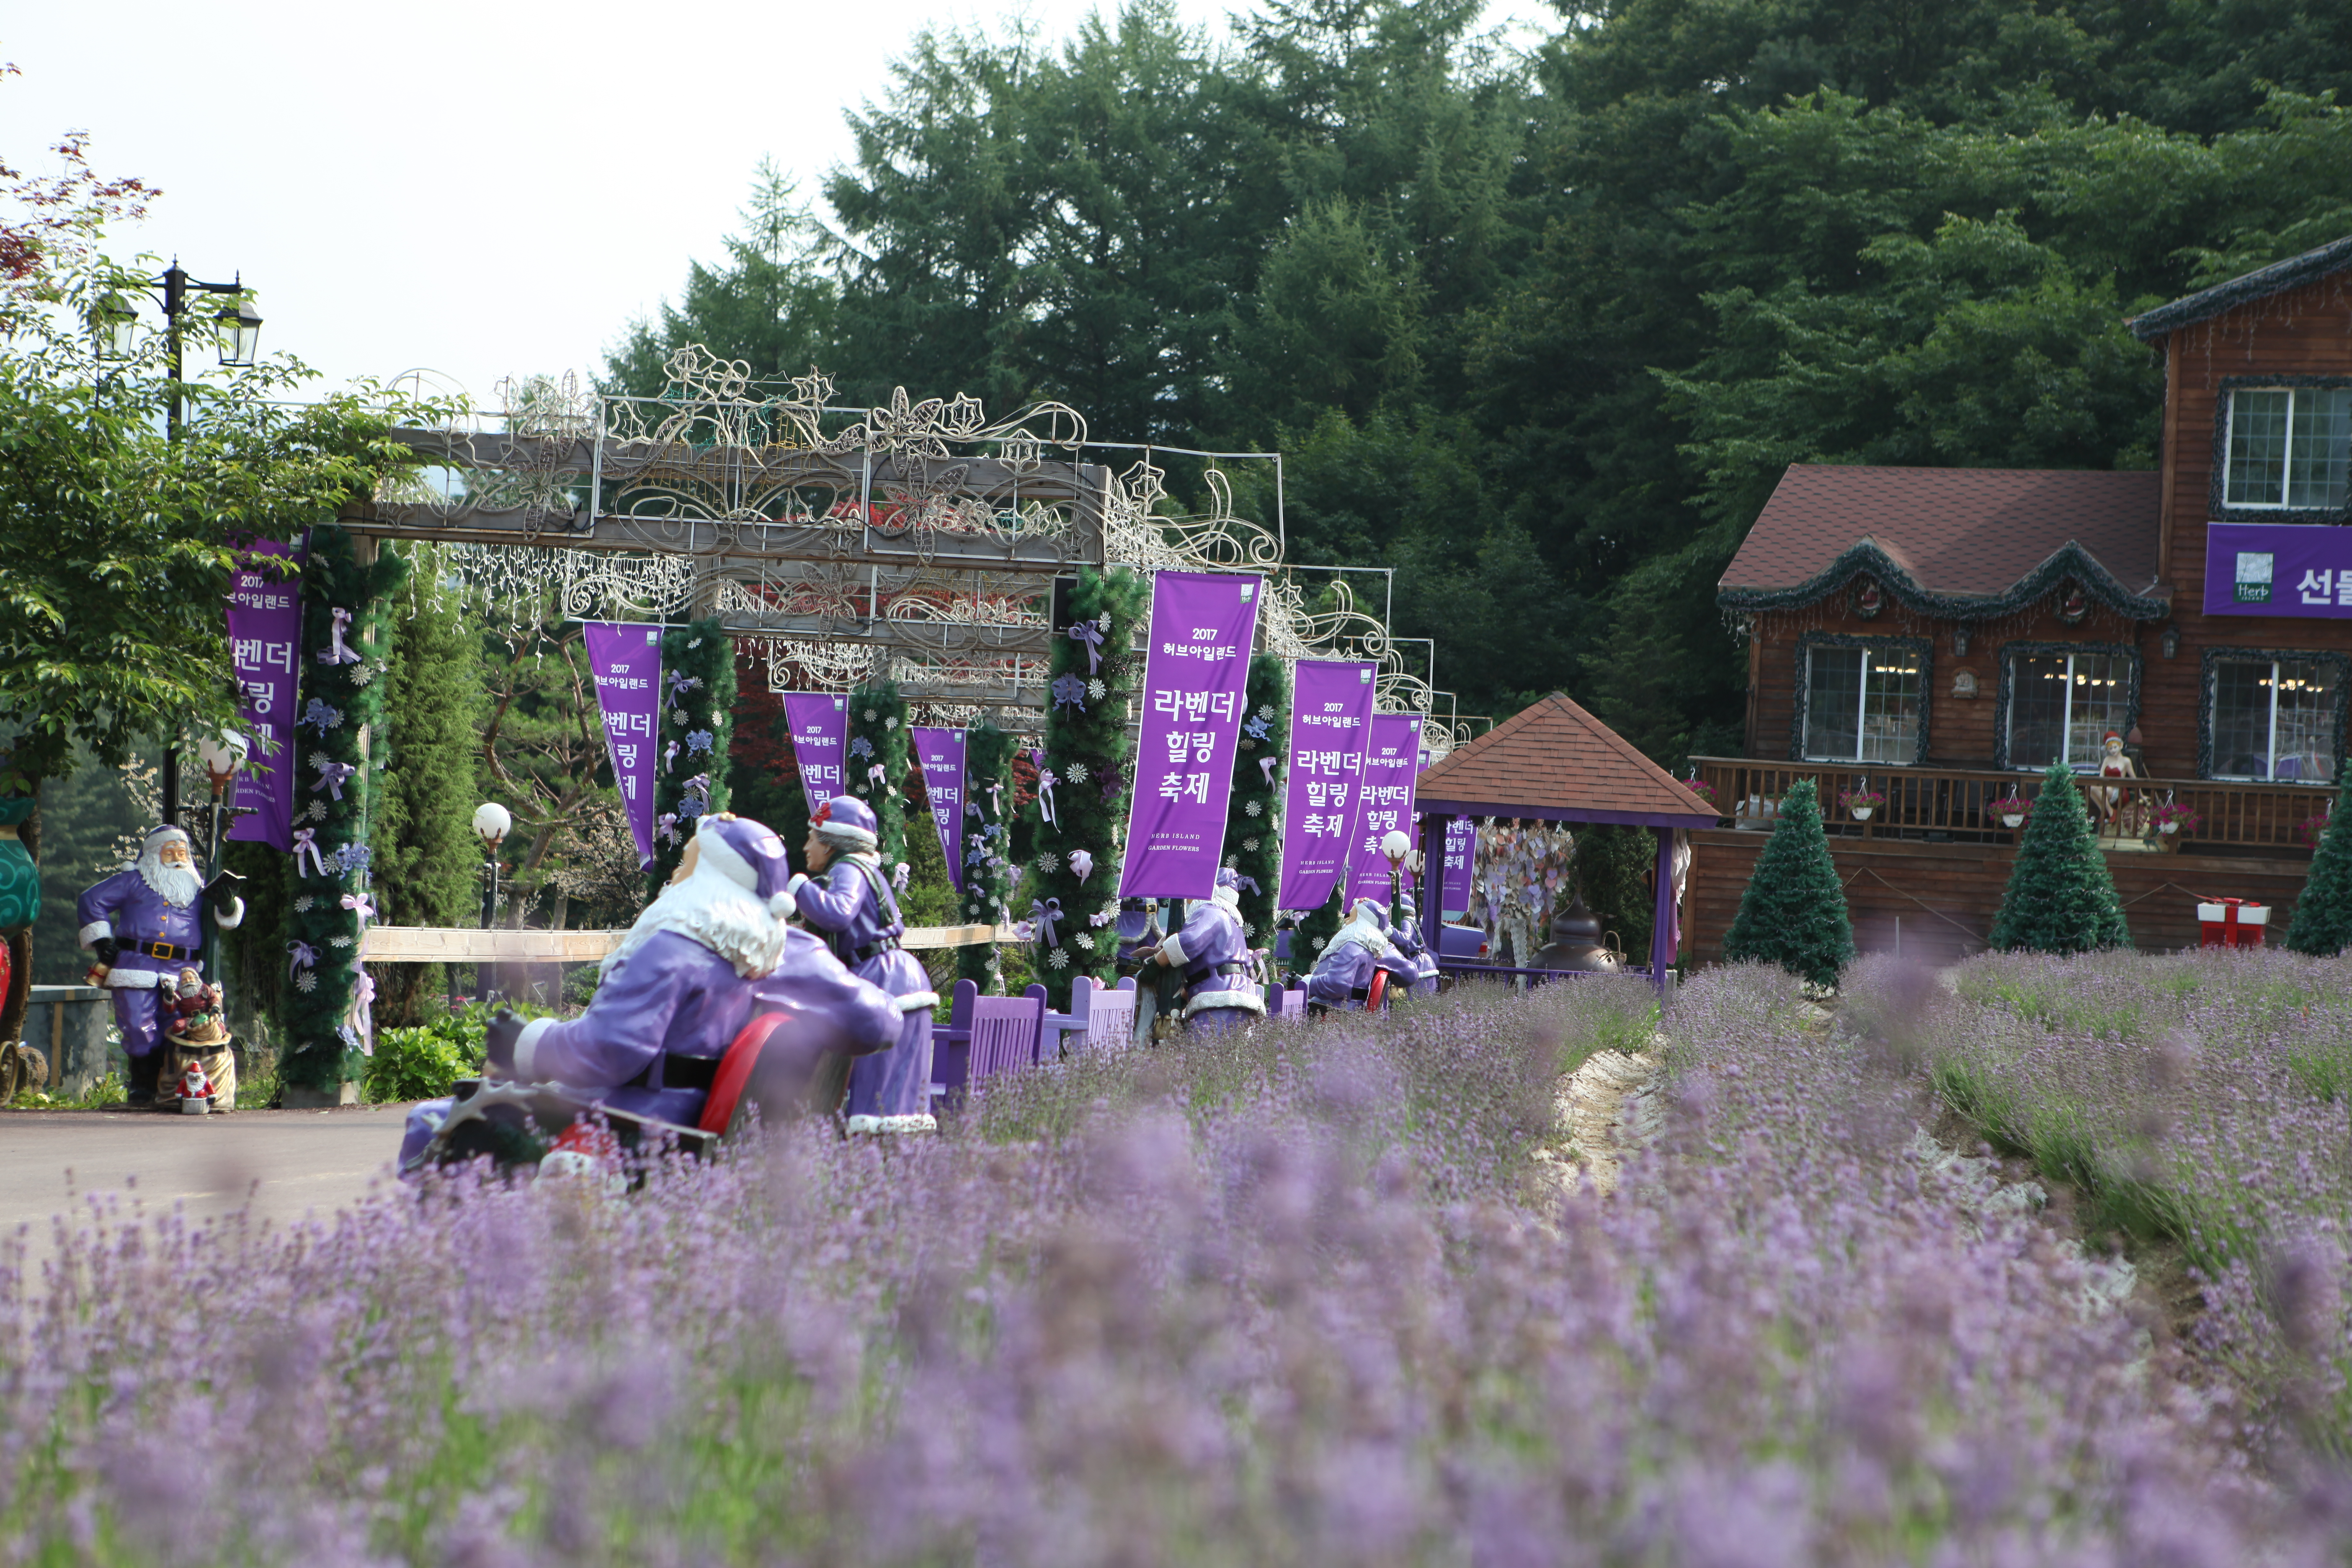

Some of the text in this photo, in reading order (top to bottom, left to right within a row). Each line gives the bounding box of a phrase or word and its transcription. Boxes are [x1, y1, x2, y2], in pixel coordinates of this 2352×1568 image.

[2239, 584, 2269, 597] Herb
[1192, 628, 1218, 641] 2017
[1163, 643, 1236, 661] 허브아일랜드
[611, 664, 630, 674] 2017
[1155, 690, 1235, 722] 라벤더
[1324, 702, 1344, 712] 2017
[1302, 714, 1361, 728] 허브아일랜드
[1166, 731, 1216, 763] 힐링
[614, 743, 637, 769] 링
[1297, 750, 1362, 776] 라벤더
[922, 762, 957, 772] 브아일랜드
[930, 787, 958, 804] 벤더
[1159, 772, 1210, 804] 축제
[1306, 781, 1349, 807] 힐링
[1361, 786, 1409, 805] 라벤더
[936, 808, 949, 825] 링
[1367, 810, 1398, 830] 힐링
[1303, 813, 1344, 838] 축제
[1445, 837, 1466, 852] 힐링
[1444, 855, 1465, 870] 축제
